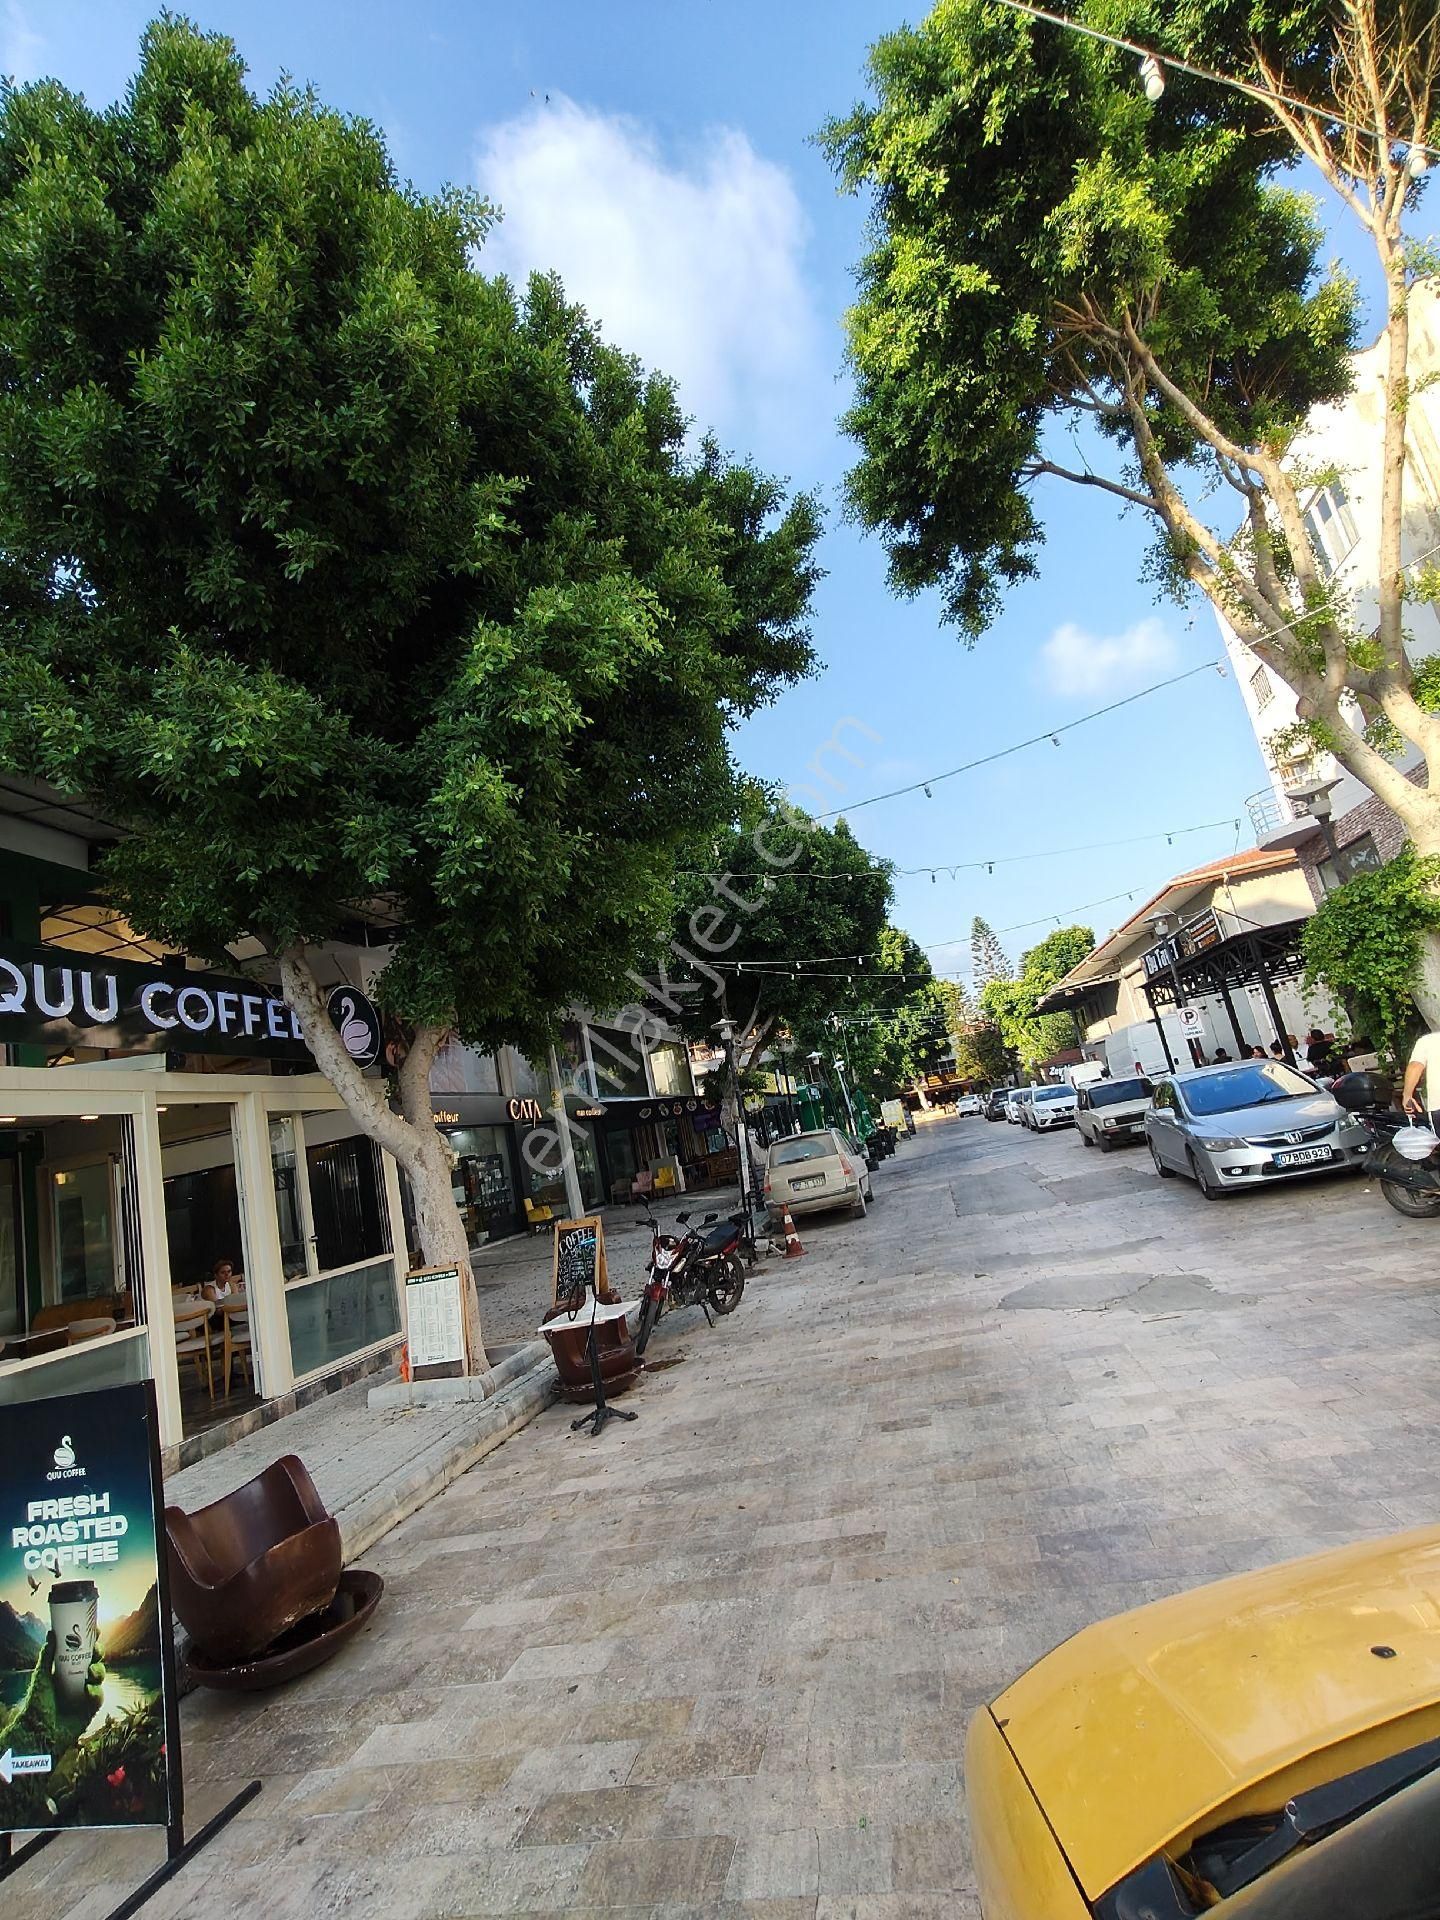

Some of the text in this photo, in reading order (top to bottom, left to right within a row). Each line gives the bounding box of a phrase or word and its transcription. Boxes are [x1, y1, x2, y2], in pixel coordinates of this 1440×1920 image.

[432, 1110, 459, 1123] oiffeur
[509, 1098, 543, 1129] CATA
[1280, 1154, 1292, 1164] 07
[1312, 1147, 1330, 1160] 929
[46, 1467, 87, 1481] QUU COFFEE
[27, 1492, 110, 1522] FRESH
[12, 1514, 128, 1548] ROASTED
[23, 1540, 119, 1570] COFFEE
[11, 1758, 50, 1769] TAKEAWAY
